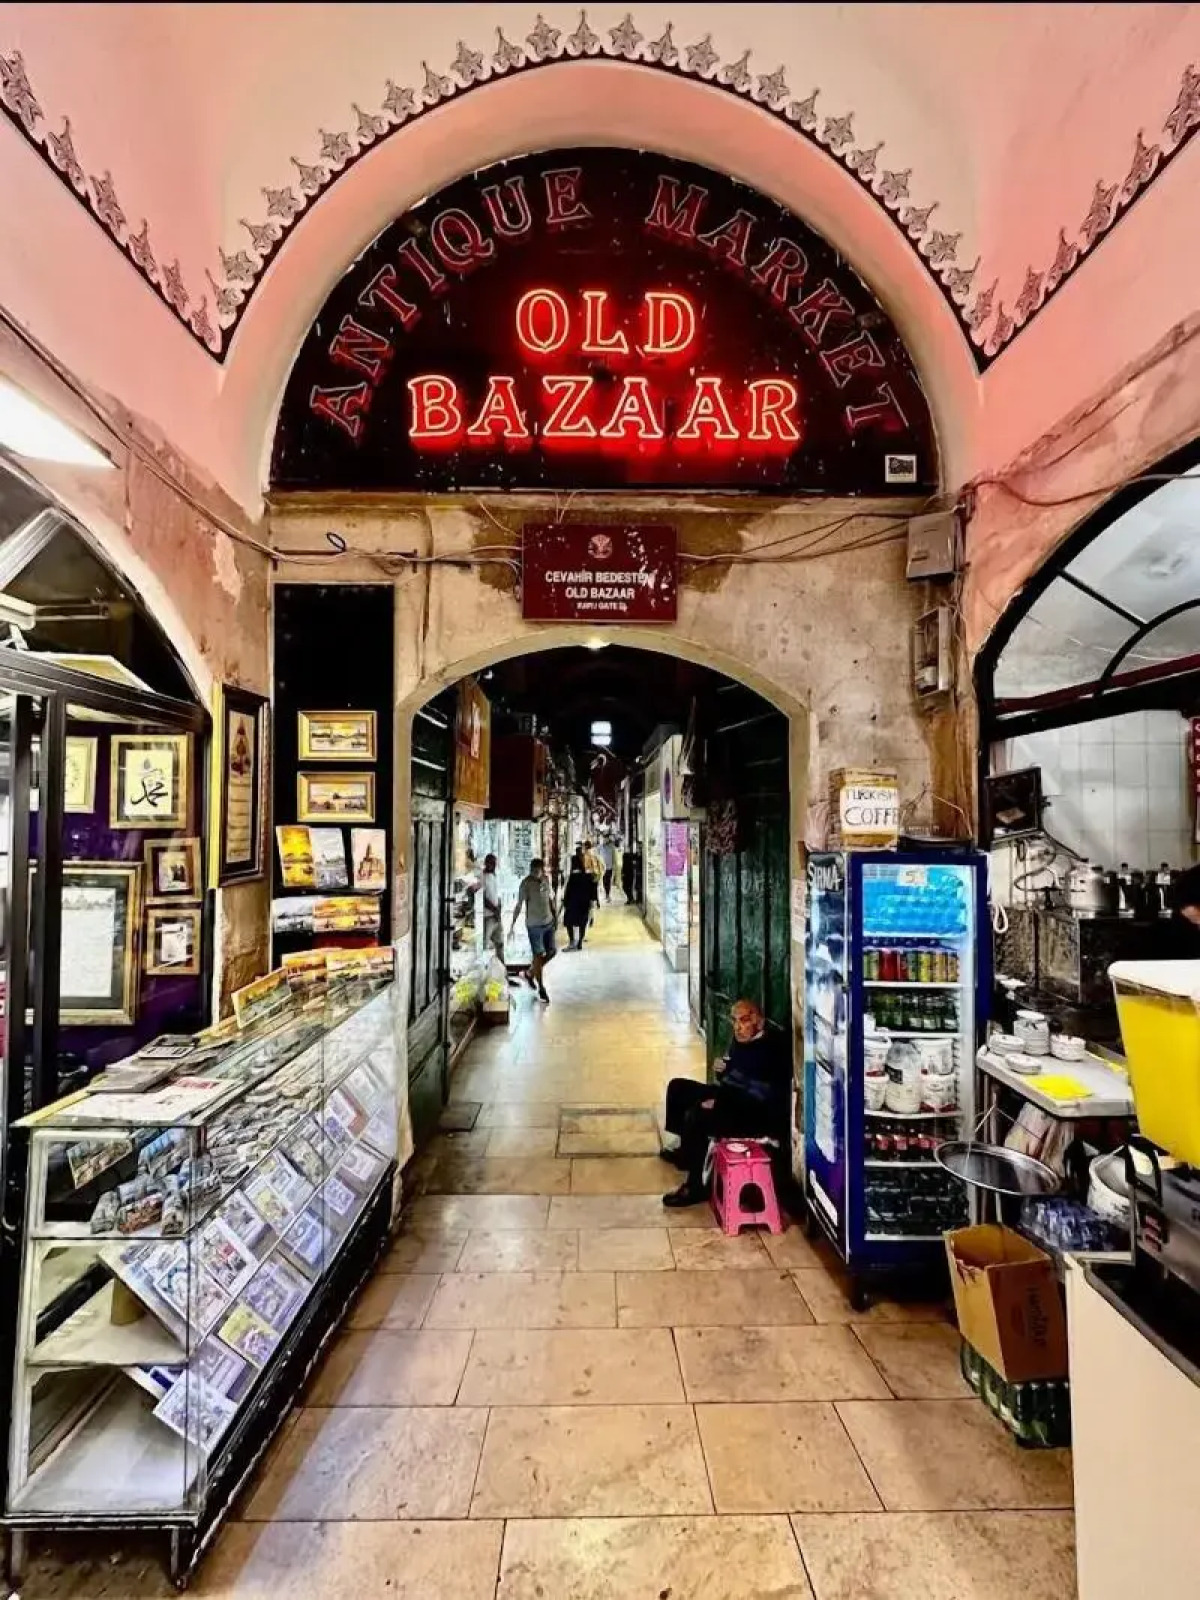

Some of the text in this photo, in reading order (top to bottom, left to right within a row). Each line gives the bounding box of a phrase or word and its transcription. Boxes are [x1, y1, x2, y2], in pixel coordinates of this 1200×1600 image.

[310, 168, 909, 437] ANTIQUE MARKET
[516, 288, 696, 353] OLD
[408, 375, 799, 440] BAZAAR
[545, 569, 593, 583] CEVAHİR
[565, 587, 636, 599] OLD BAZAAR
